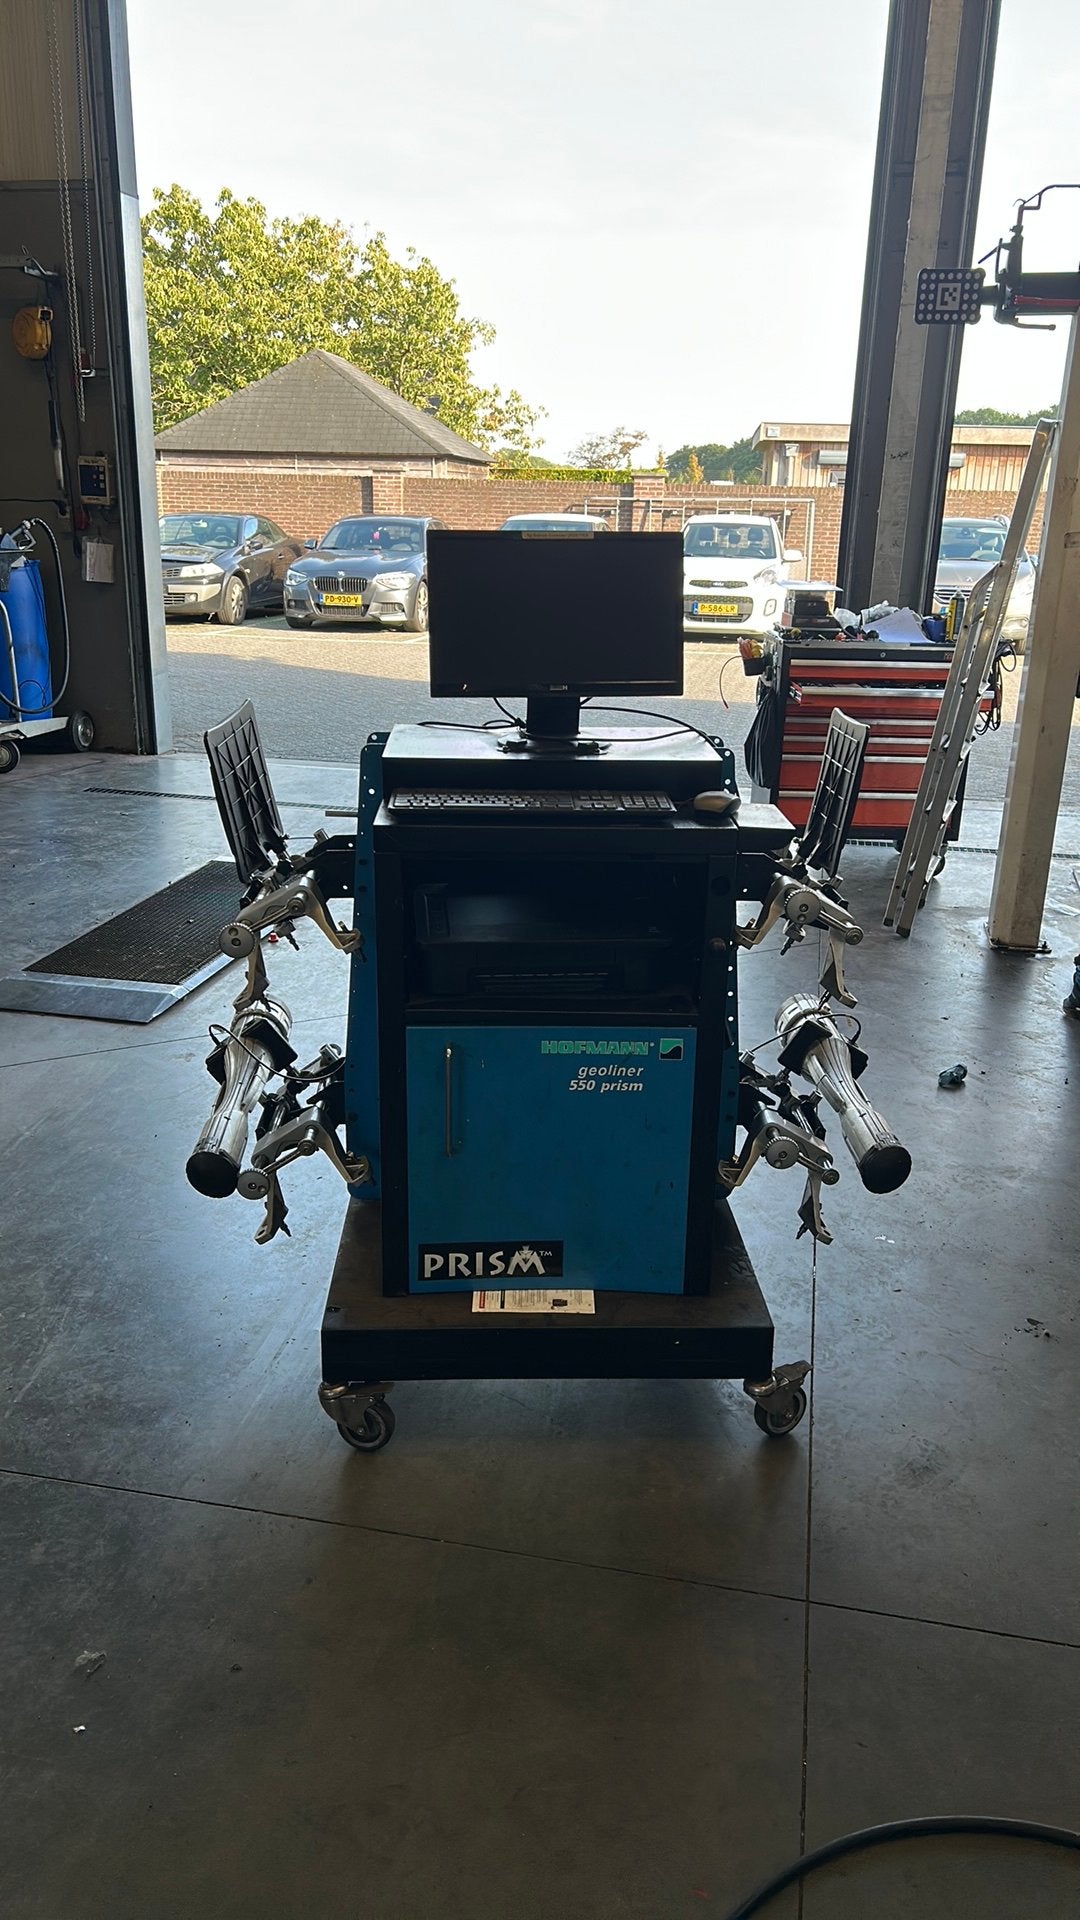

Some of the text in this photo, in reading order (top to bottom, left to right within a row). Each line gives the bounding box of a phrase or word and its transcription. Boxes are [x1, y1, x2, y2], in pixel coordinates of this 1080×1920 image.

[325, 595, 359, 604] PD-930-V
[701, 604, 736, 612] P-586-LR
[541, 1040, 648, 1055] HOFMANN
[578, 1065, 644, 1079] geoliner
[568, 1080, 643, 1093] 550 prism
